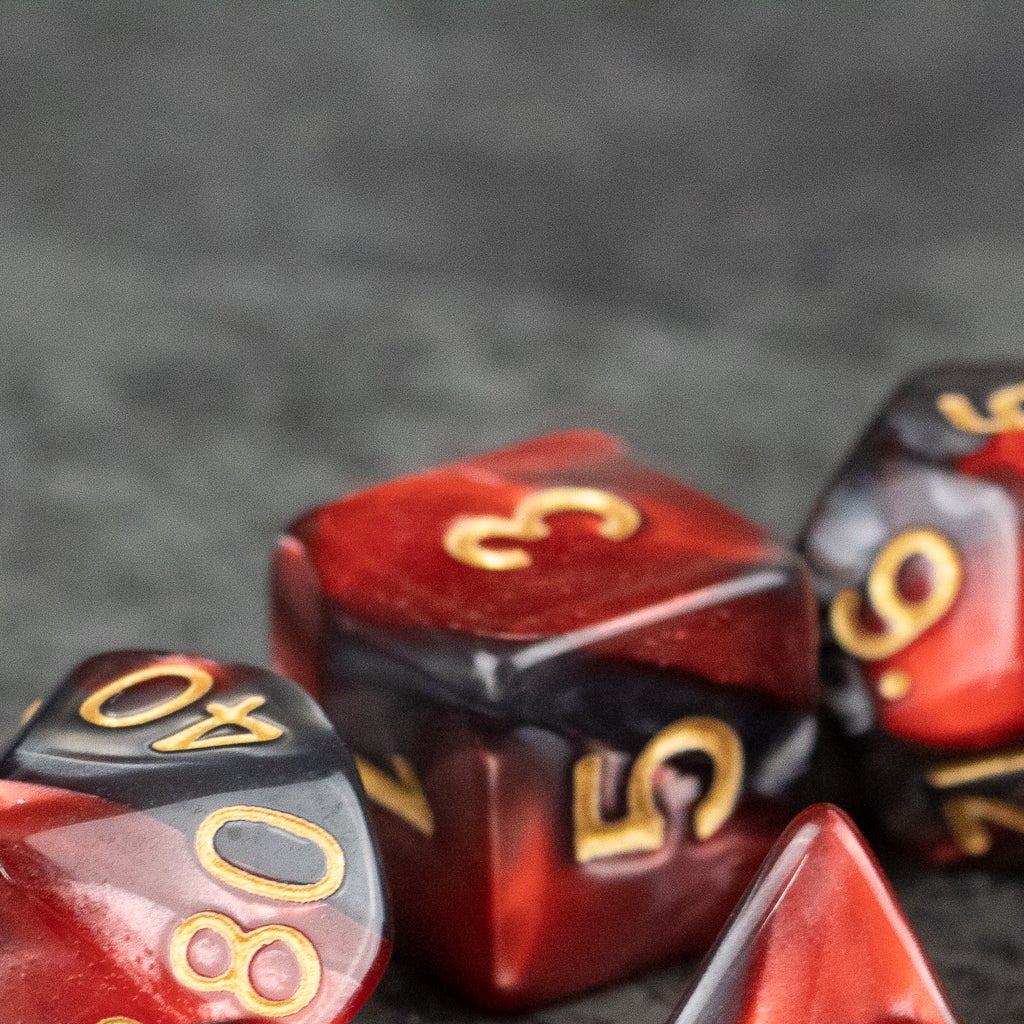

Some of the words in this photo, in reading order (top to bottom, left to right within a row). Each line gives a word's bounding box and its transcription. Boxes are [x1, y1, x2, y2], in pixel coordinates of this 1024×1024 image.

[444, 487, 641, 570] 3
[80, 663, 284, 752] 40
[573, 717, 745, 862] 5
[170, 805, 346, 1018] 80
